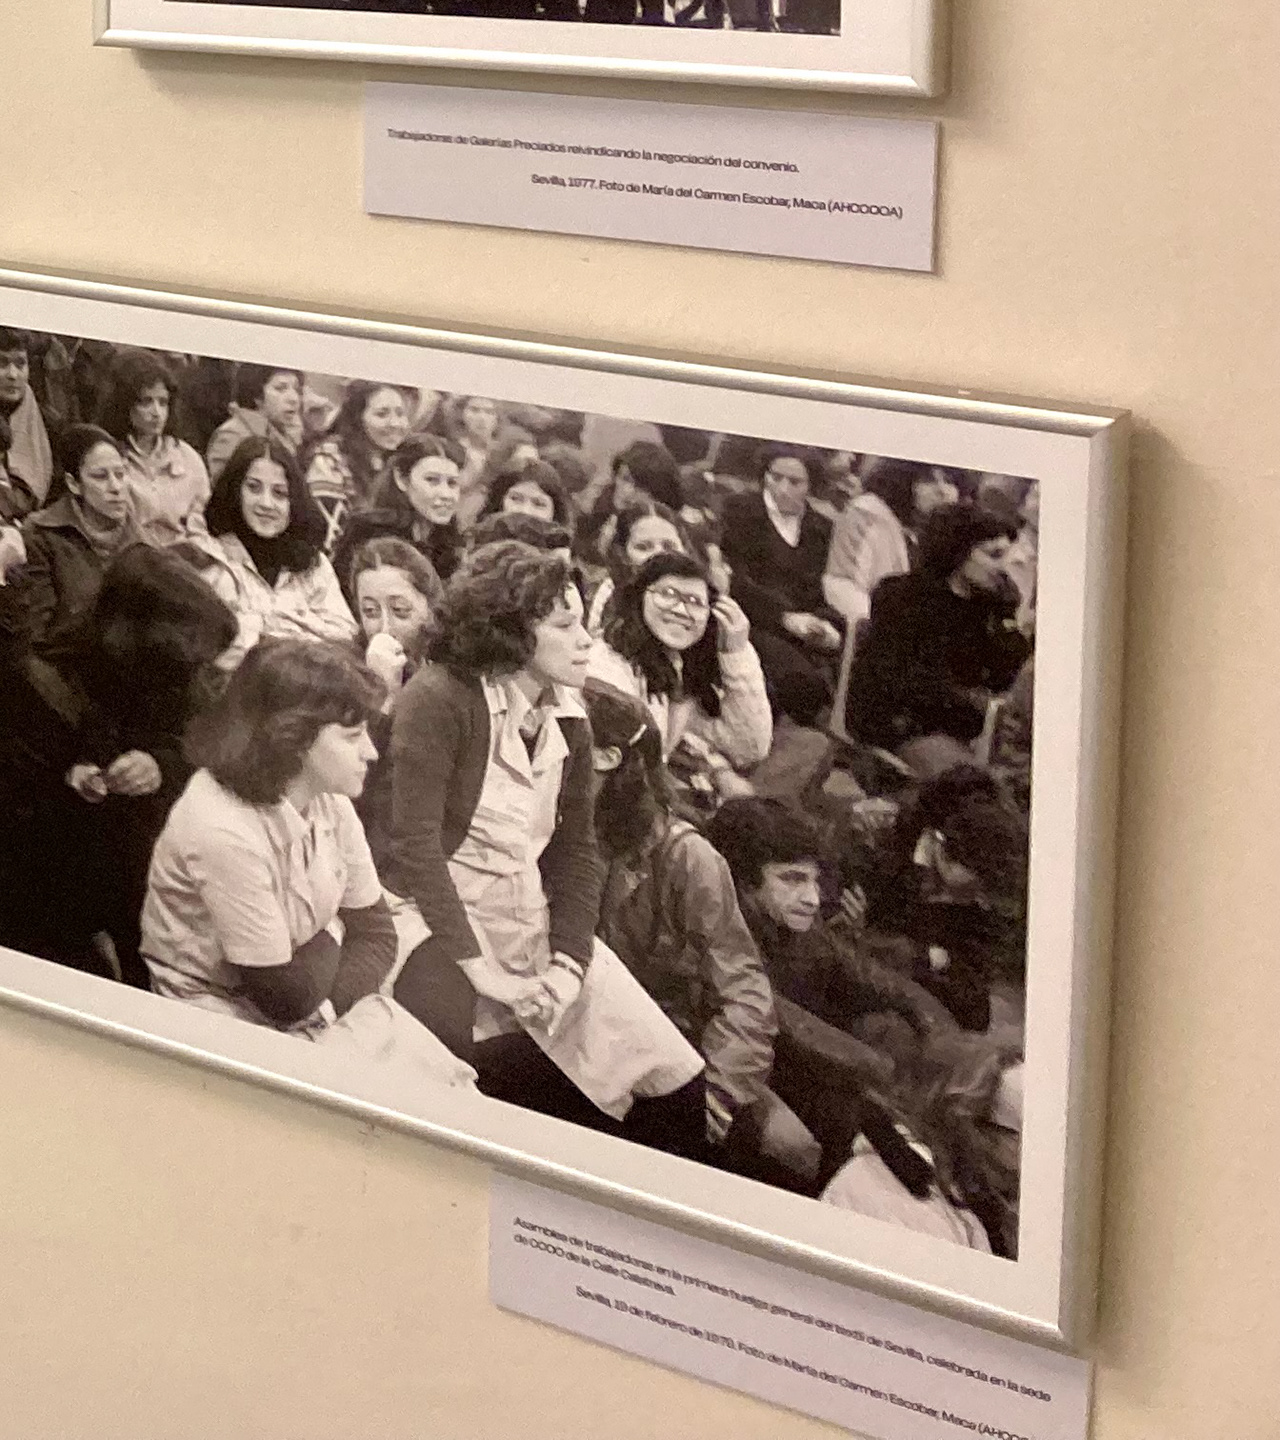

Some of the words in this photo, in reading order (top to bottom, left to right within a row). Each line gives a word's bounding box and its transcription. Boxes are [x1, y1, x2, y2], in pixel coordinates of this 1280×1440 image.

[513, 140, 565, 153] Preciados
[642, 150, 651, 160] la
[653, 153, 722, 166] negociación
[723, 158, 741, 167] del
[742, 160, 799, 172] convenio.
[599, 180, 624, 191] Foto
[625, 184, 640, 193] de
[642, 184, 674, 196] María
[674, 188, 692, 197] del
[694, 189, 741, 202] Carmen
[741, 193, 791, 209] Escobar,
[792, 198, 826, 210] Maca
[865, 1336, 883, 1347] de
[884, 1341, 925, 1362] Sevilla,
[925, 1356, 988, 1381] celebrada
[989, 1377, 1006, 1386] en
[1006, 1380, 1018, 1392] la
[1019, 1386, 1051, 1401] sede
[838, 1378, 888, 1400] Carmen
[941, 1411, 976, 1430] Maca
